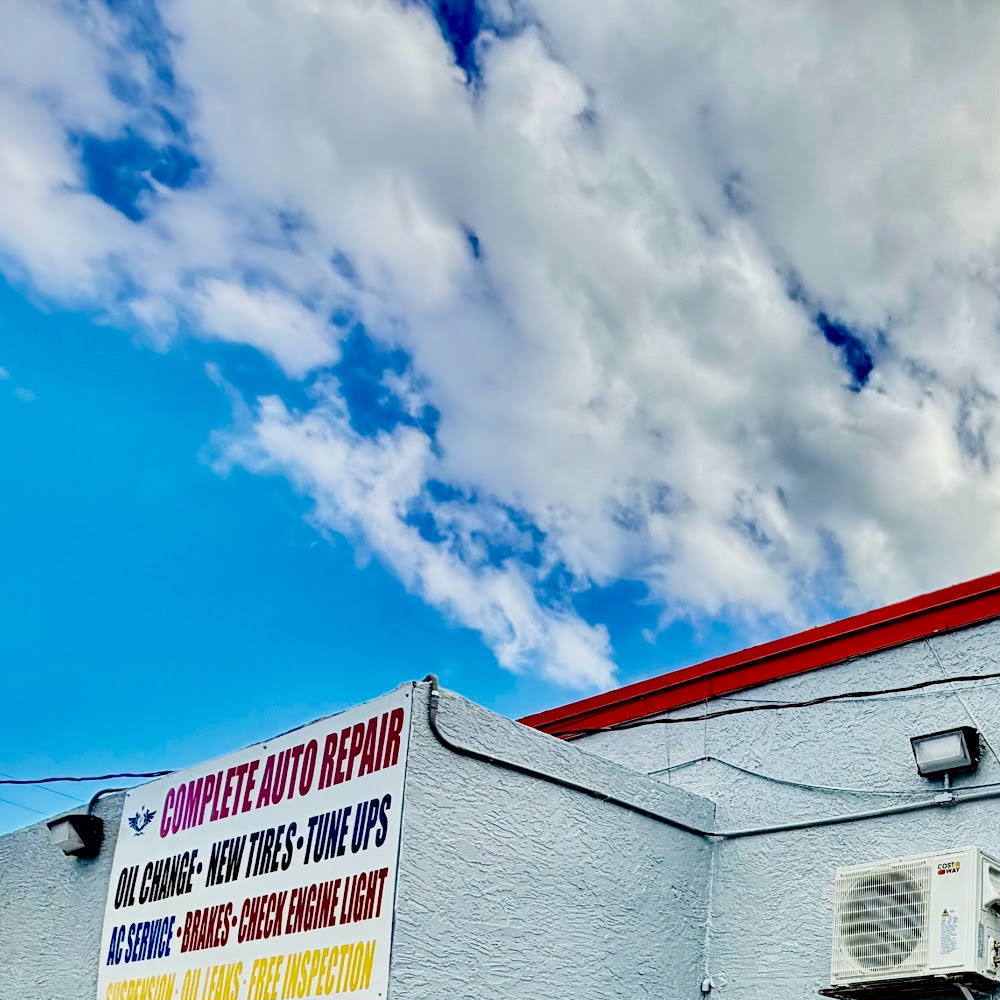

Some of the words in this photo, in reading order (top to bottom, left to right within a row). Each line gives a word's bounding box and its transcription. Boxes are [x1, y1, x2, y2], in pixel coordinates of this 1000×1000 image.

[160, 760, 259, 838] COMPLETE
[256, 739, 318, 809] AUTO
[318, 707, 404, 790] REPAIR
[114, 863, 139, 909] OIL
[207, 835, 247, 887] NEW
[351, 794, 392, 854] UPS
[938, 861, 955, 870] COST
[106, 922, 125, 965] AC
[124, 915, 176, 963] SERVICE
[285, 878, 342, 935] ENGINE
[340, 867, 389, 924] LIGHT
[282, 940, 376, 1000] INSPECTION
